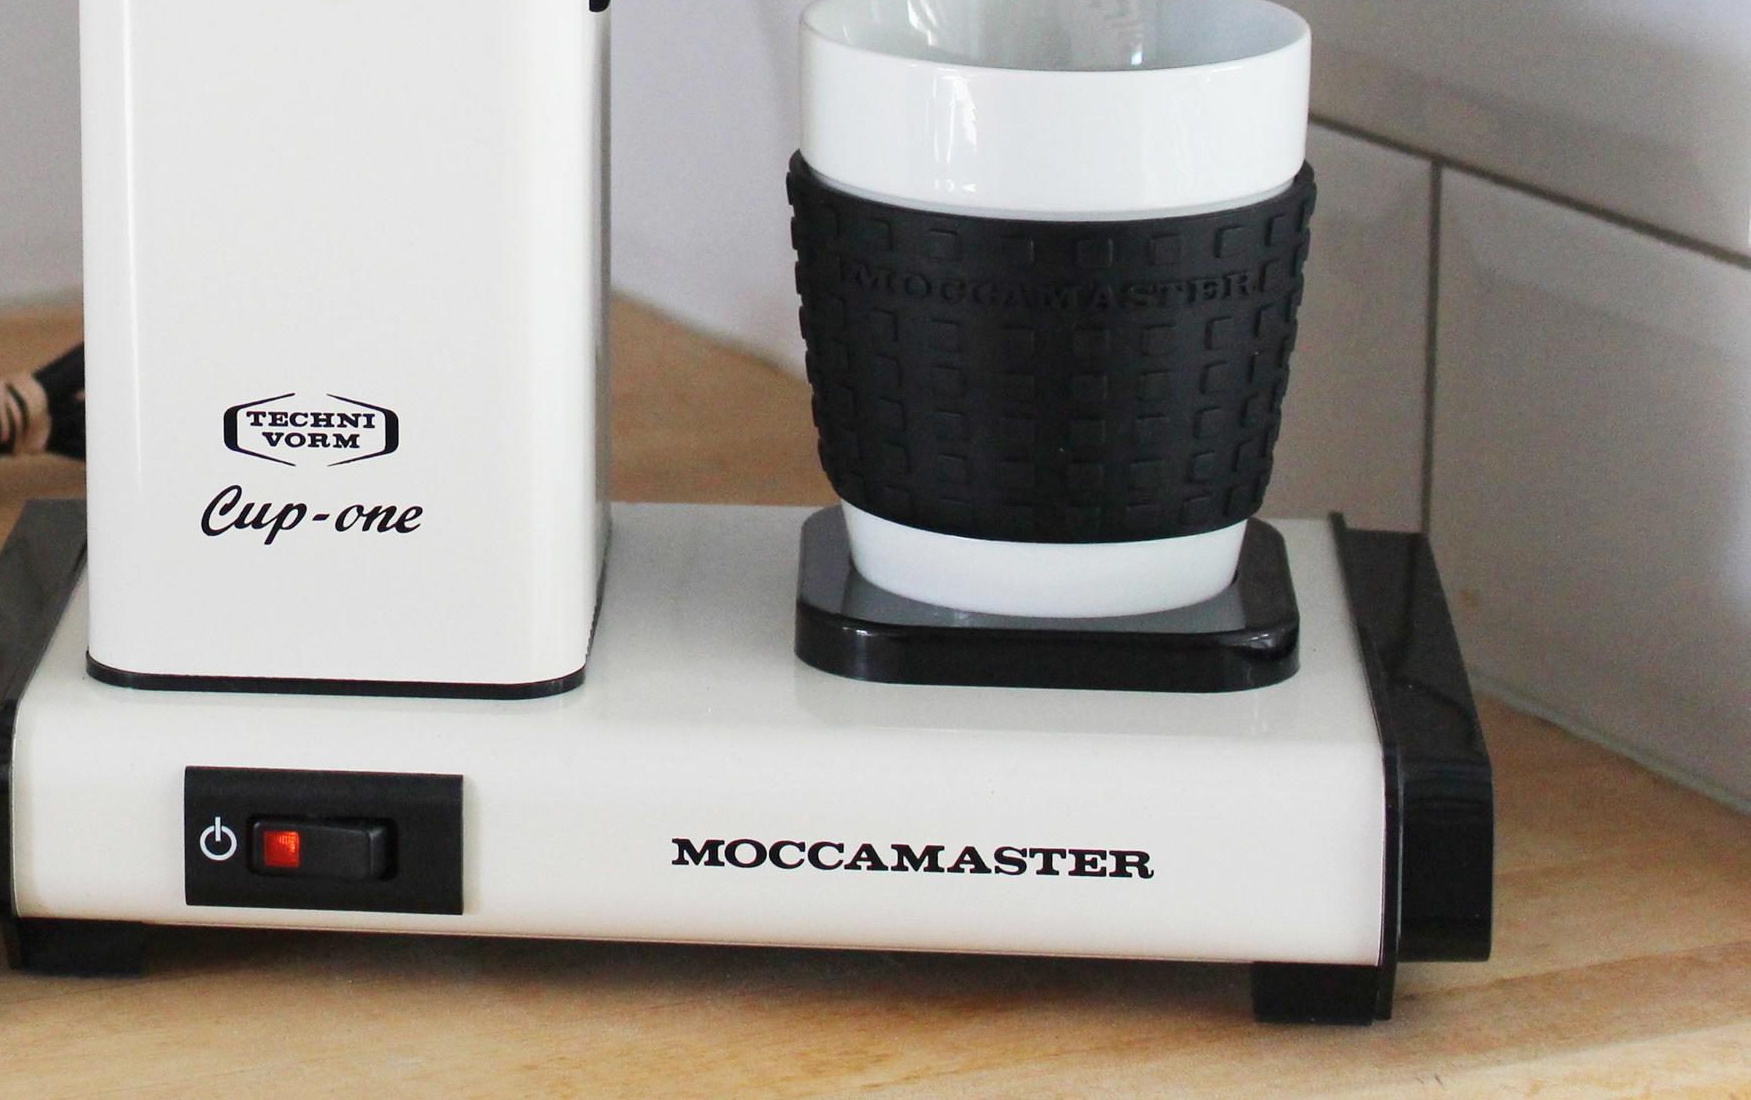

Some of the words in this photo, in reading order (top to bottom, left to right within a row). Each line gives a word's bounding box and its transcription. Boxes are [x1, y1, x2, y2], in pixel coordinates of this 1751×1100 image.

[851, 260, 1256, 312] MOCCAMASTER
[246, 411, 376, 429] TECHNI
[262, 431, 361, 449] VORM
[200, 484, 424, 545] Cup-one
[671, 837, 1155, 879] MOCCAMASTER
